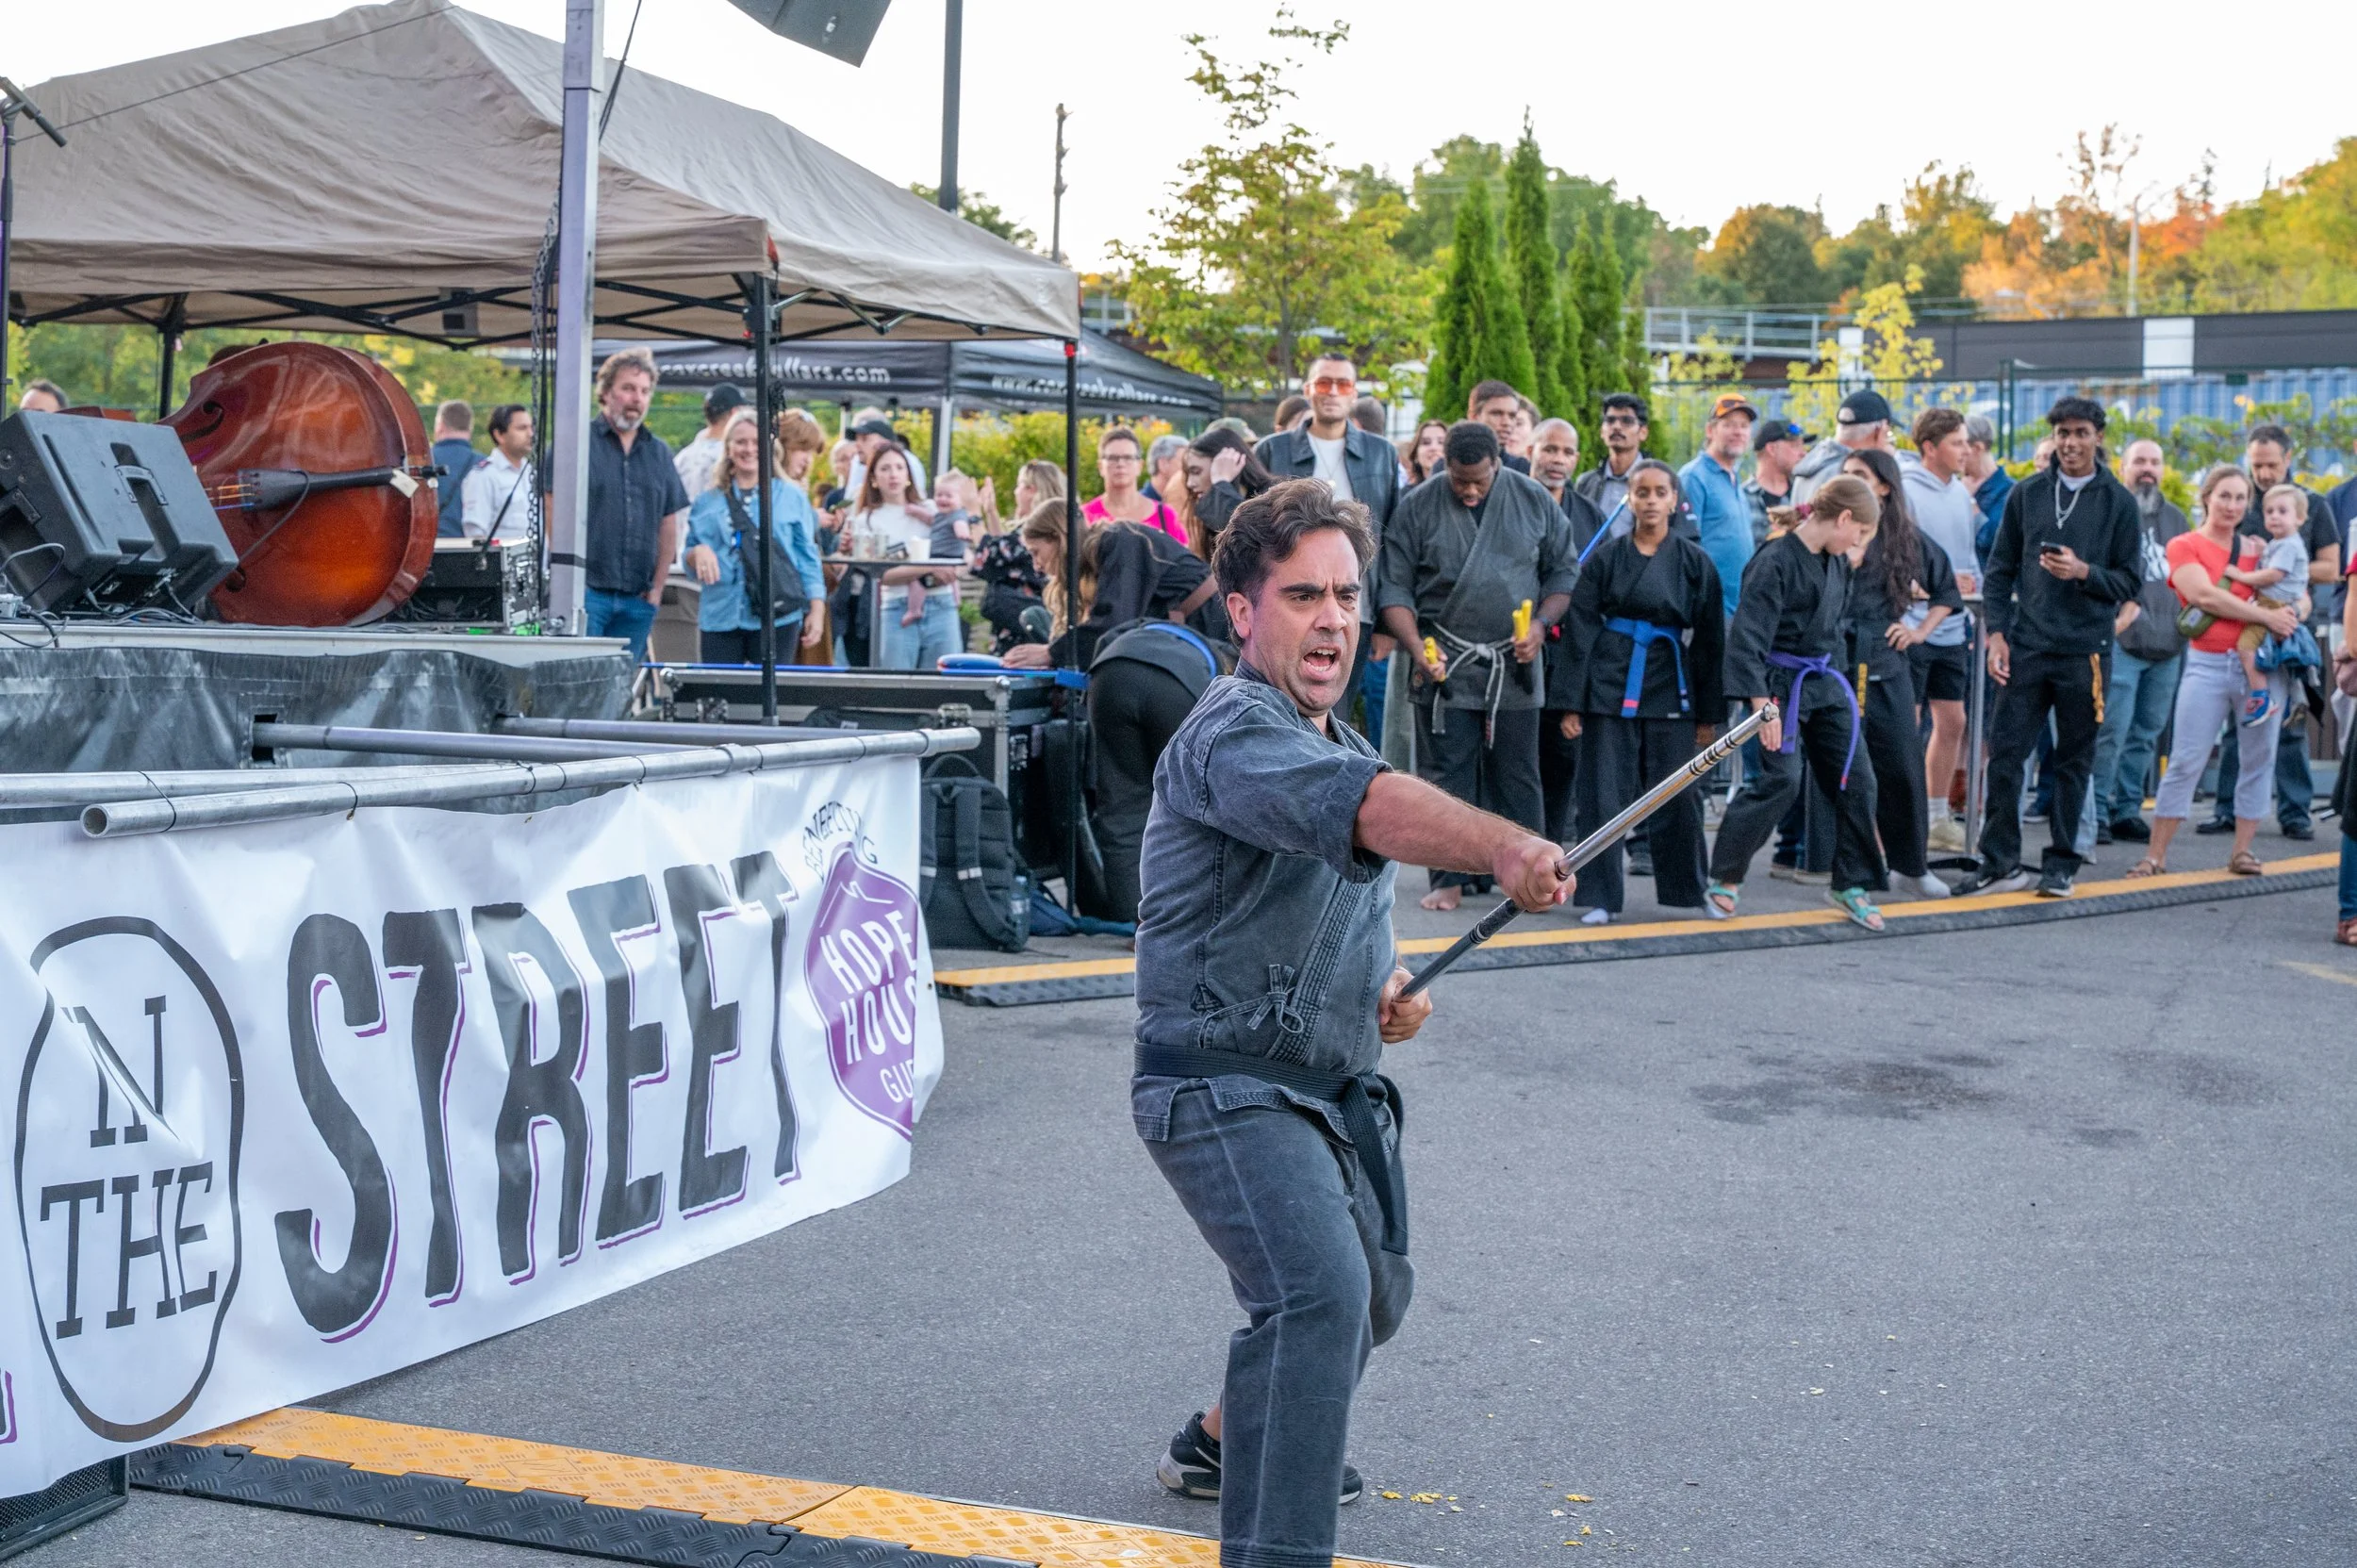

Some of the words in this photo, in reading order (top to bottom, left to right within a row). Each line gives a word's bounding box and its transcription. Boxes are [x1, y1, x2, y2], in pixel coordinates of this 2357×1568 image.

[820, 910, 916, 994] HOPE
[274, 850, 799, 1343] STREET
[41, 1162, 217, 1339] THE
